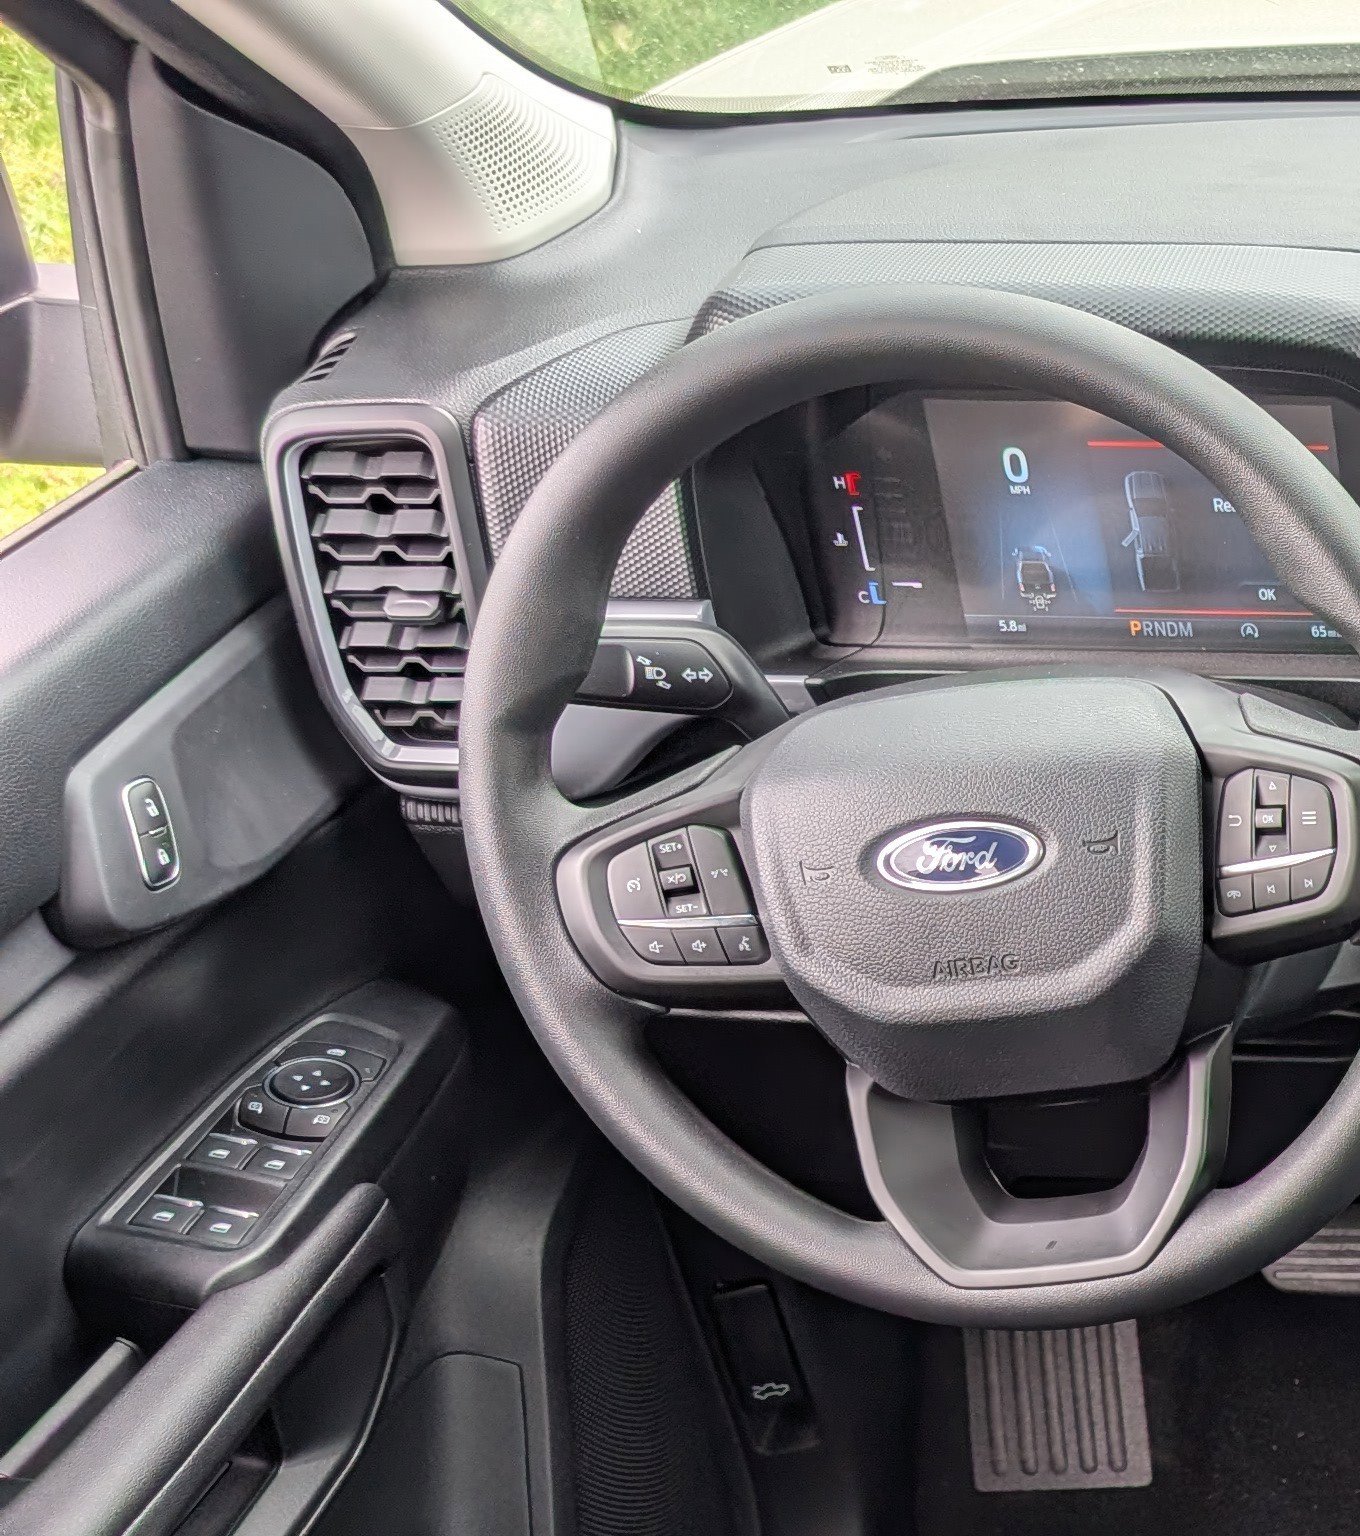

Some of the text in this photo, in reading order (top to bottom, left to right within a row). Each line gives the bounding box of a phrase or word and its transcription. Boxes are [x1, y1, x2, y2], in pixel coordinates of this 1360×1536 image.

[1002, 447, 1030, 484] 0
[1009, 485, 1031, 496] MPH
[1258, 588, 1277, 602] OK
[932, 953, 1021, 980] AIRBAG
